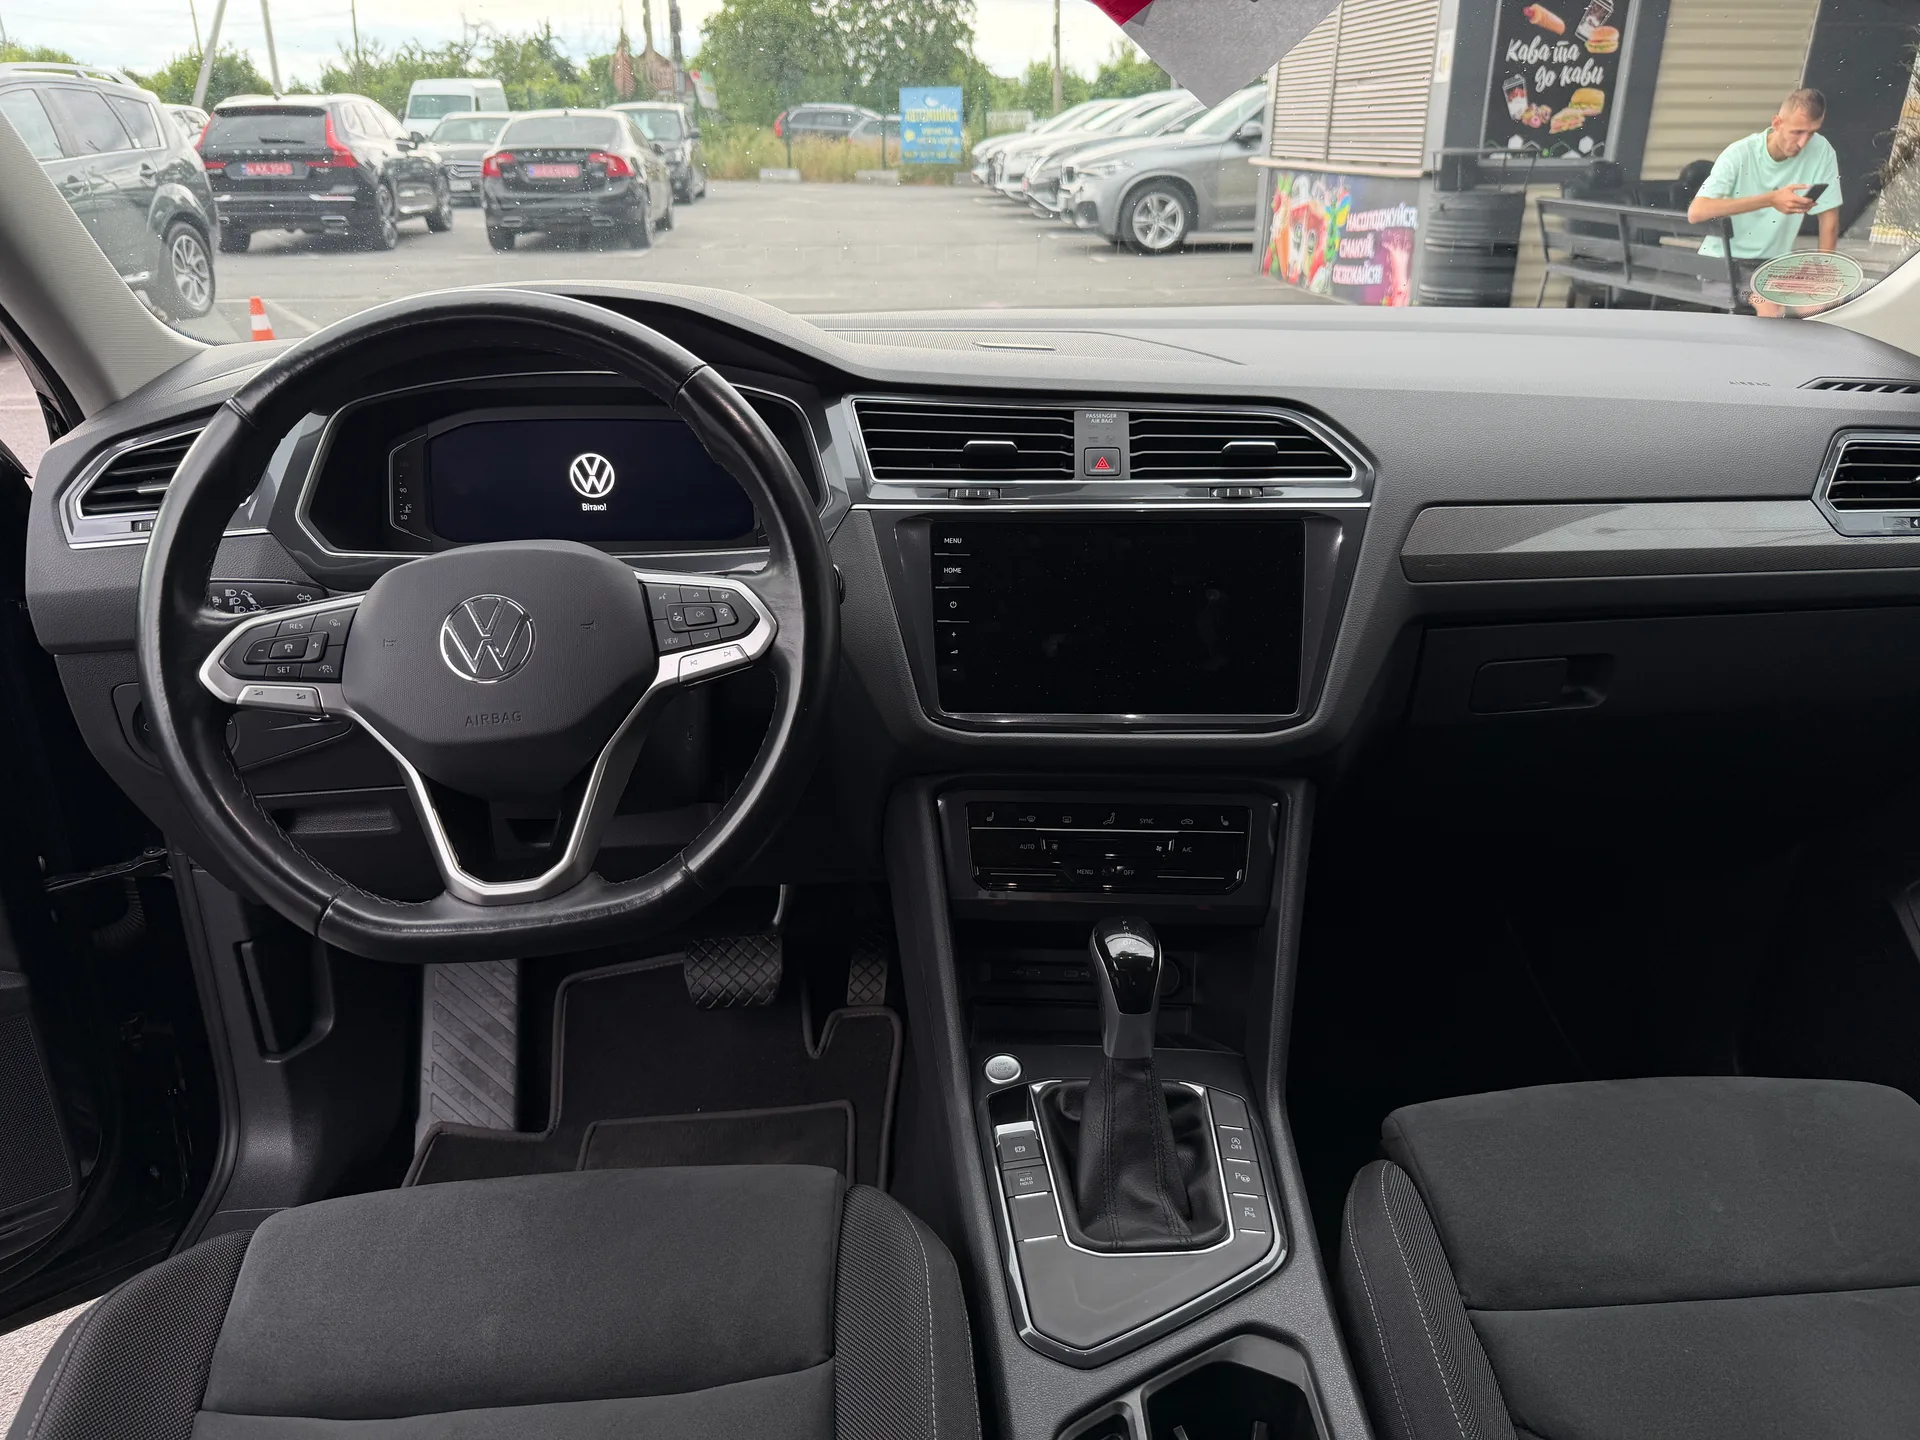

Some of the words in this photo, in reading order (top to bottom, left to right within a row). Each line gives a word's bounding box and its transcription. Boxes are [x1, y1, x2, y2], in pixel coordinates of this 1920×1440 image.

[1506, 35, 1551, 64] Кава
[1553, 41, 1580, 63] та
[1535, 65, 1556, 92] до
[1560, 58, 1604, 87] кави
[582, 502, 607, 512] Вітаю!
[289, 622, 304, 630] RES
[664, 637, 679, 645] VIEW
[277, 666, 291, 674] SET
[465, 710, 522, 727] AIRBAG
[1139, 817, 1154, 825] SYNC
[1076, 868, 1094, 876] MENU
